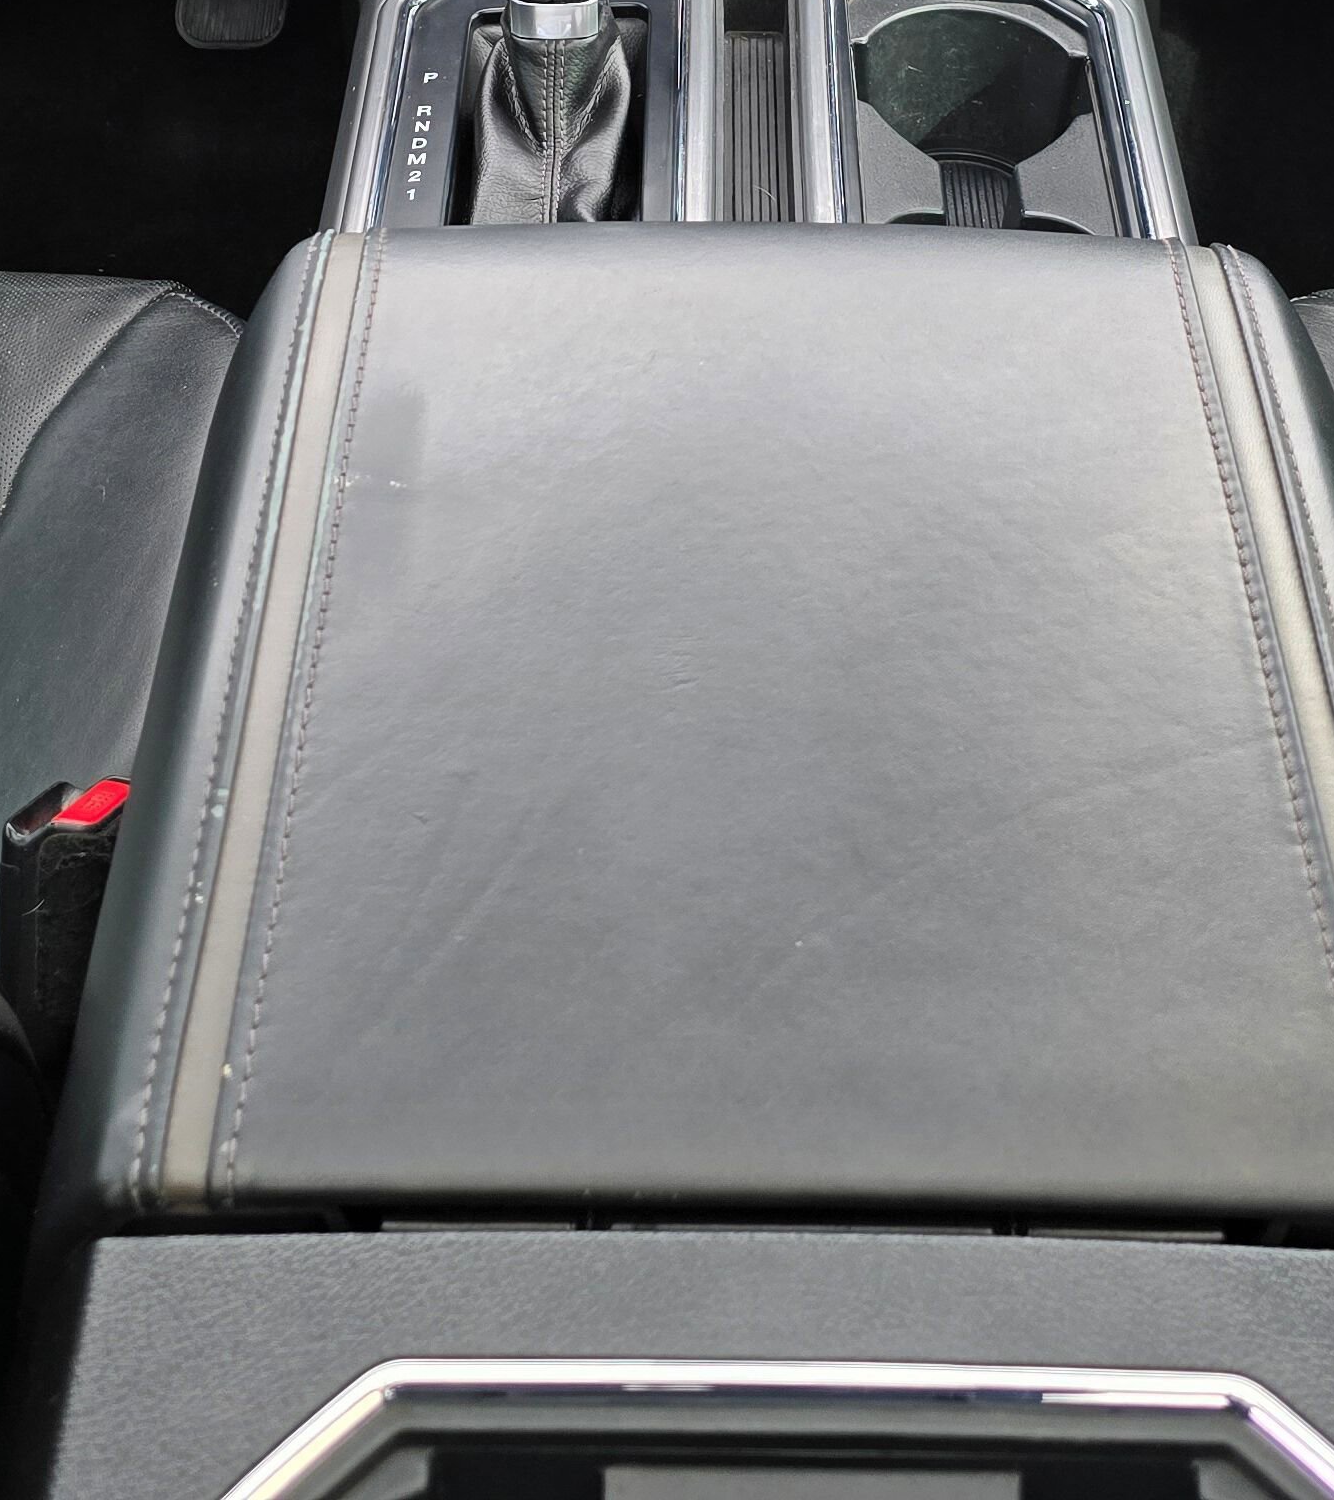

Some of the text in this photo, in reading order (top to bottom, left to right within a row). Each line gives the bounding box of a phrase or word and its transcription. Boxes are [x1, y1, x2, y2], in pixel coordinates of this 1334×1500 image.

[423, 72, 439, 84] P
[416, 105, 432, 117] R
[414, 121, 431, 132] N
[411, 138, 428, 150] D
[407, 153, 427, 166] M
[407, 170, 422, 183] 2
[406, 188, 417, 201] 1
